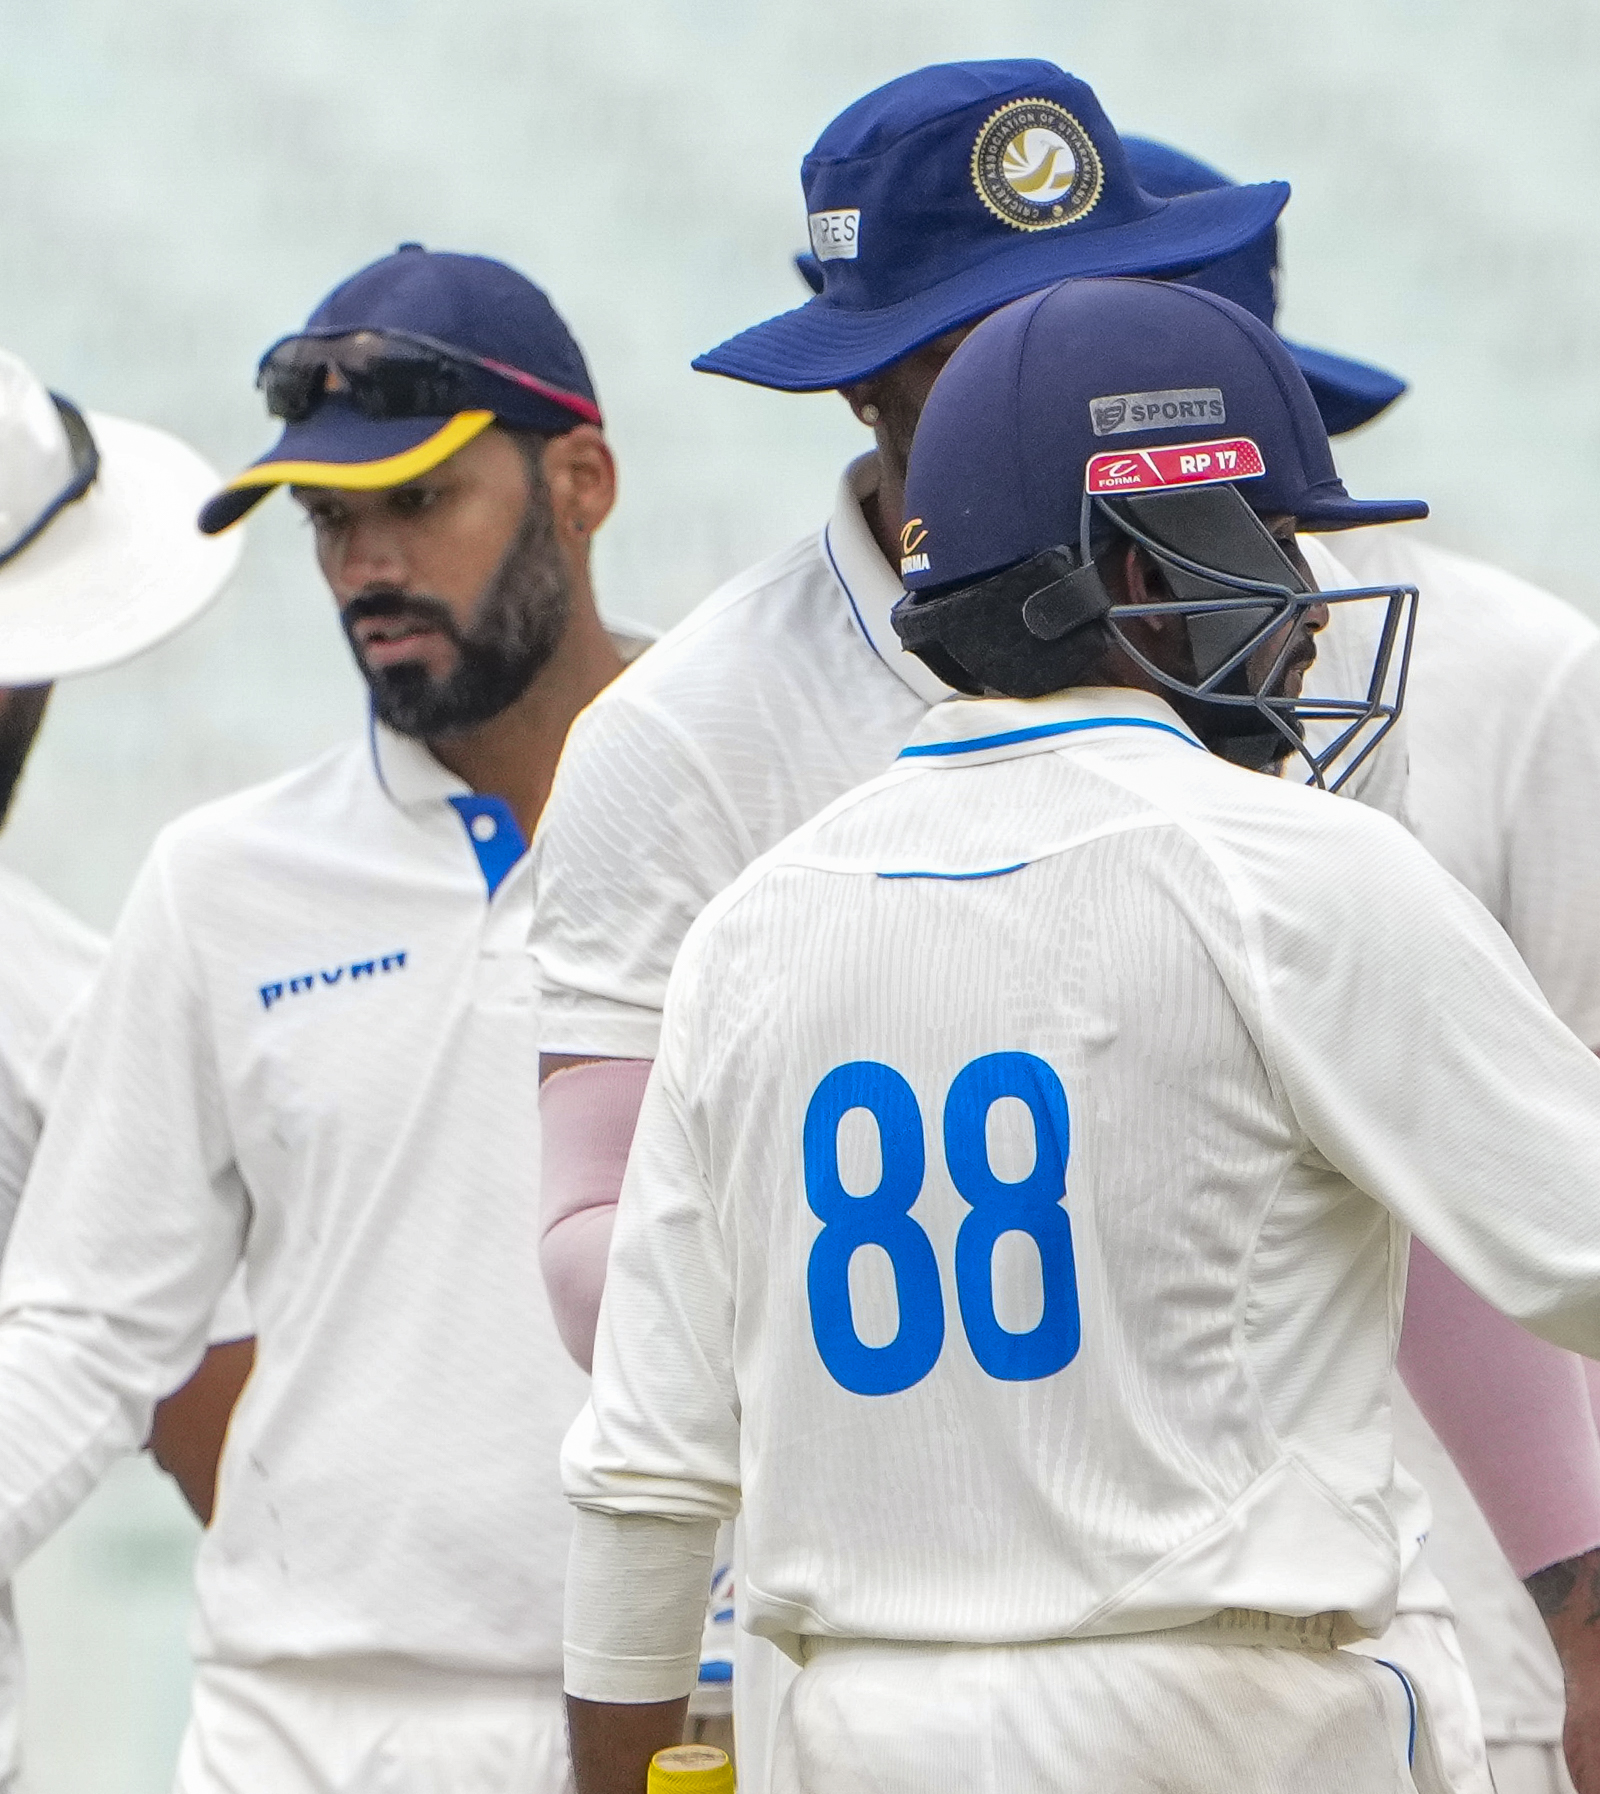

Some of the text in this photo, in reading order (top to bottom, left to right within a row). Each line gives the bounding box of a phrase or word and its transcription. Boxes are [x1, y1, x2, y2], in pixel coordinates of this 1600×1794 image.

[1131, 399, 1224, 422] SPORTS
[1179, 450, 1237, 475] RP 17
[1098, 475, 1142, 487] FORMA
[802, 1050, 1082, 1397] 88
